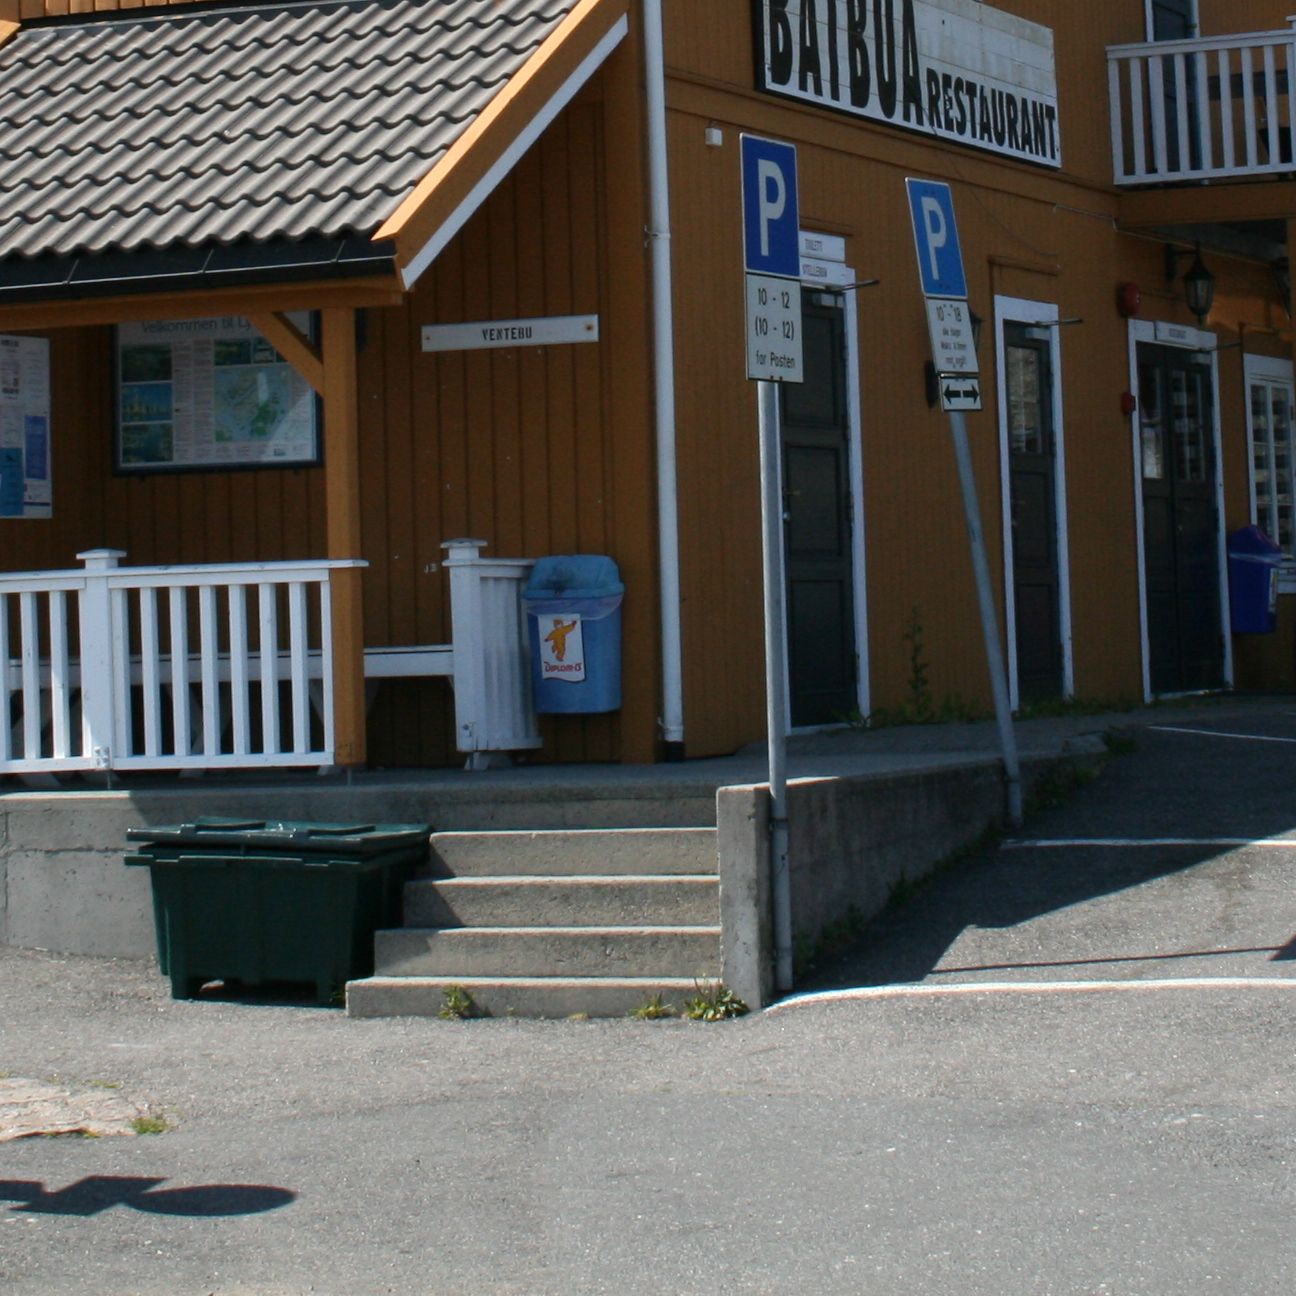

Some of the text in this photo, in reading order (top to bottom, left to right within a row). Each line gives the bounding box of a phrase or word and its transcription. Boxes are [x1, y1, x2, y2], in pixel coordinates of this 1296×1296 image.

[926, 67, 1056, 160] RESTAURANT
[757, 158, 787, 257] P
[920, 195, 947, 281] P
[758, 287, 768, 306] 10
[781, 291, 790, 309] 12
[142, 319, 217, 333] Velkommen
[755, 315, 768, 337] (10
[782, 320, 795, 341] 12)
[770, 351, 796, 369] Posten
